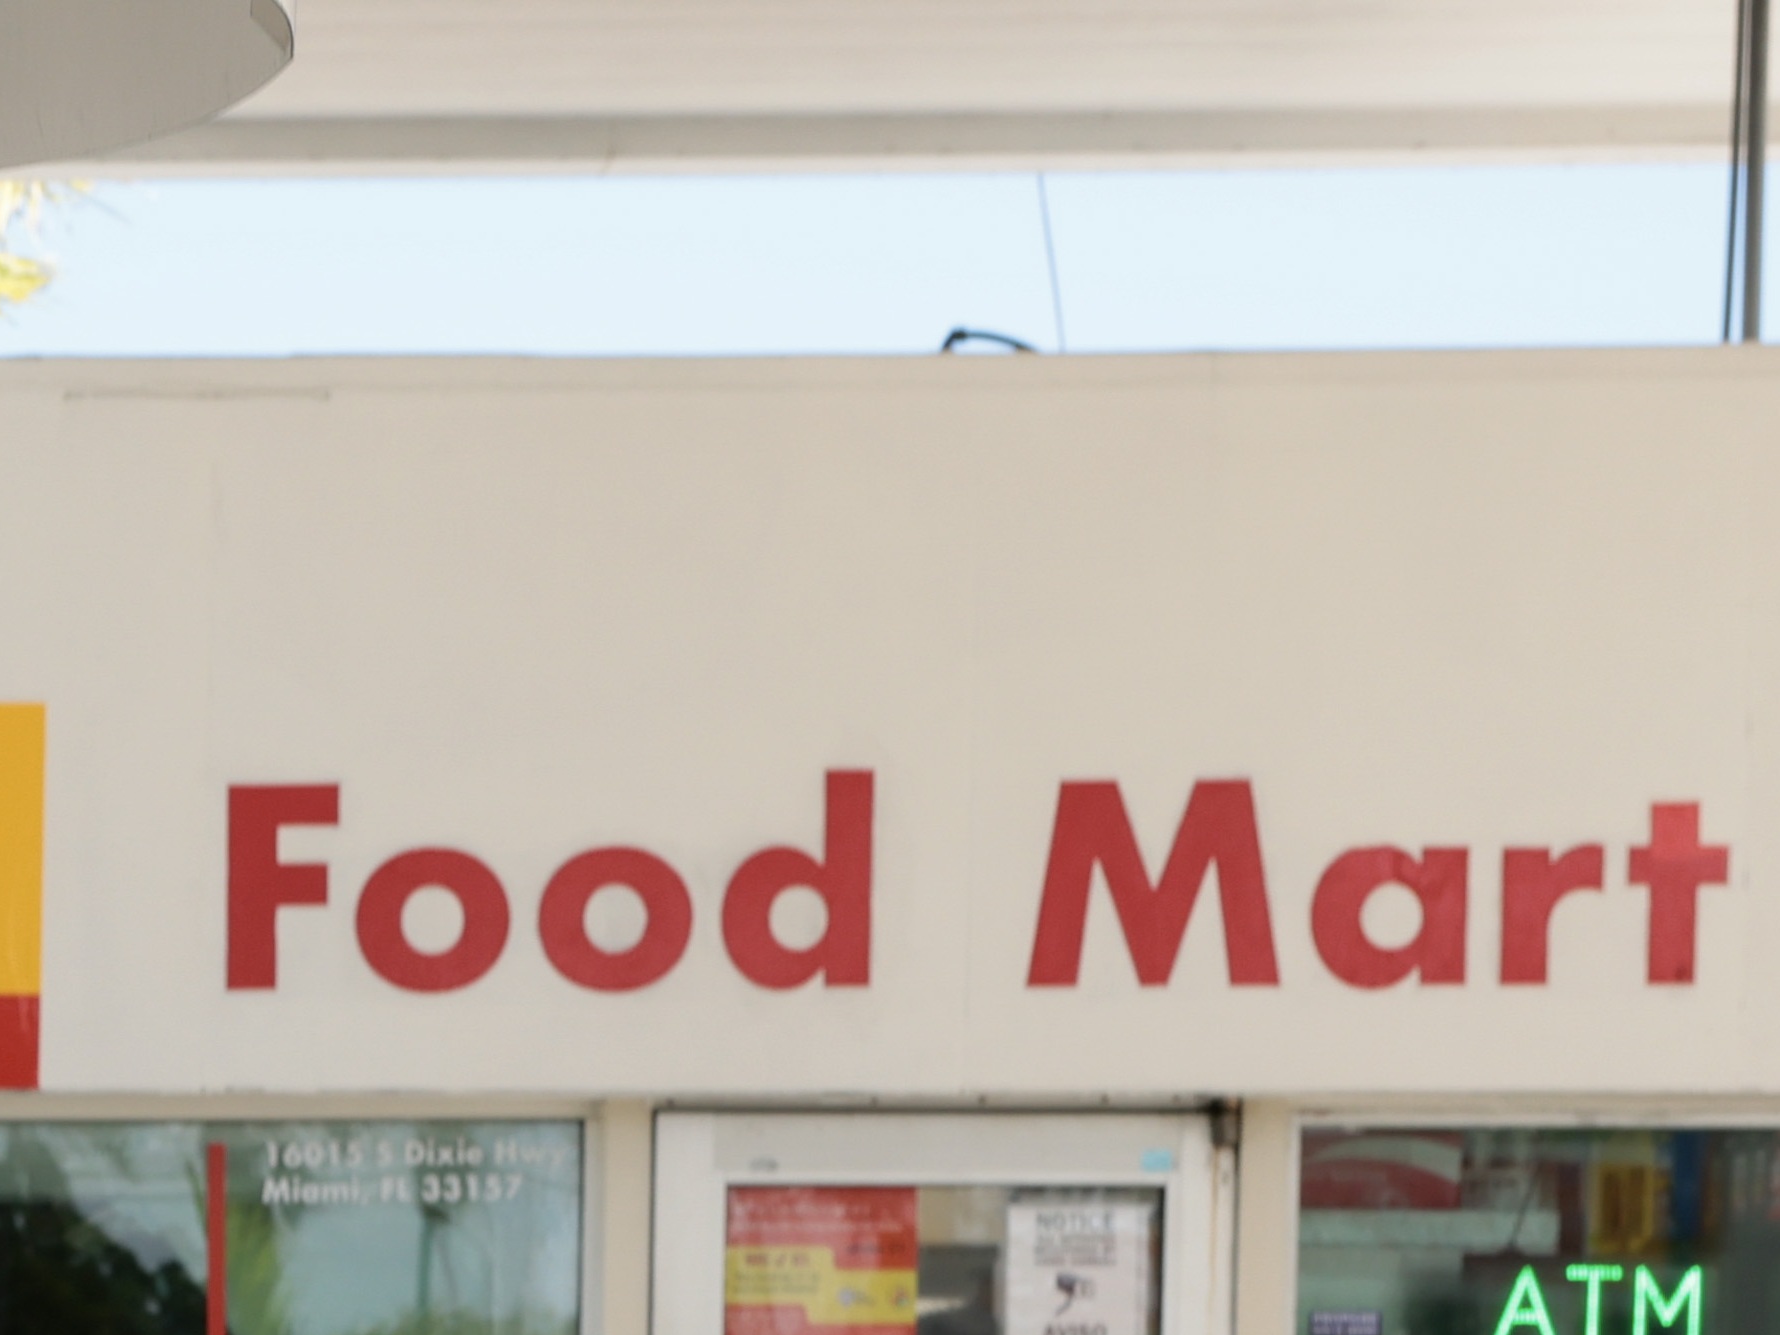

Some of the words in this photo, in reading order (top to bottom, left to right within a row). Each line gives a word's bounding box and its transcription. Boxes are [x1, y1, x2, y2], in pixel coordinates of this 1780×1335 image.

[225, 768, 875, 995] Food
[1025, 778, 1730, 991] Mart
[405, 1136, 484, 1166] Dixie
[380, 1177, 409, 1201] FL
[421, 1173, 523, 1202] 33157
